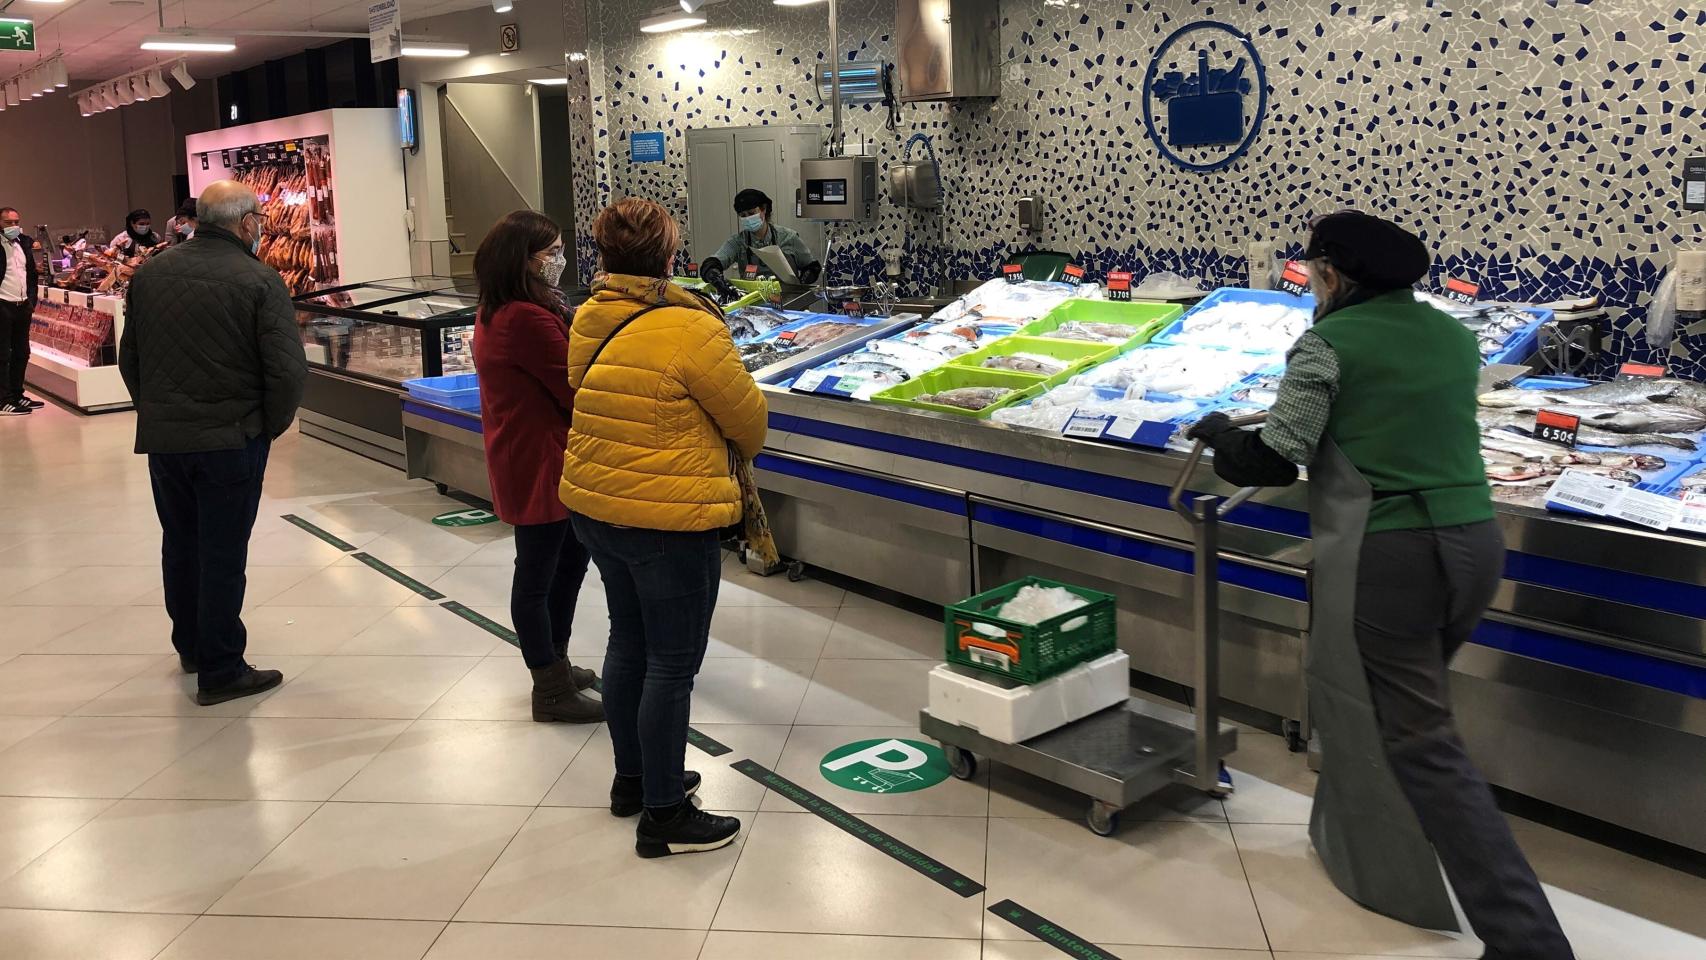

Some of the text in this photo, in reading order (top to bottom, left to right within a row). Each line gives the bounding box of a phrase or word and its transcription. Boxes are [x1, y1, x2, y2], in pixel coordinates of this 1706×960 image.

[822, 739, 928, 771] P
[763, 774, 809, 801] Mantenga
[820, 805, 868, 833] distancia
[867, 831, 884, 843] de
[882, 842, 944, 873] seguridad
